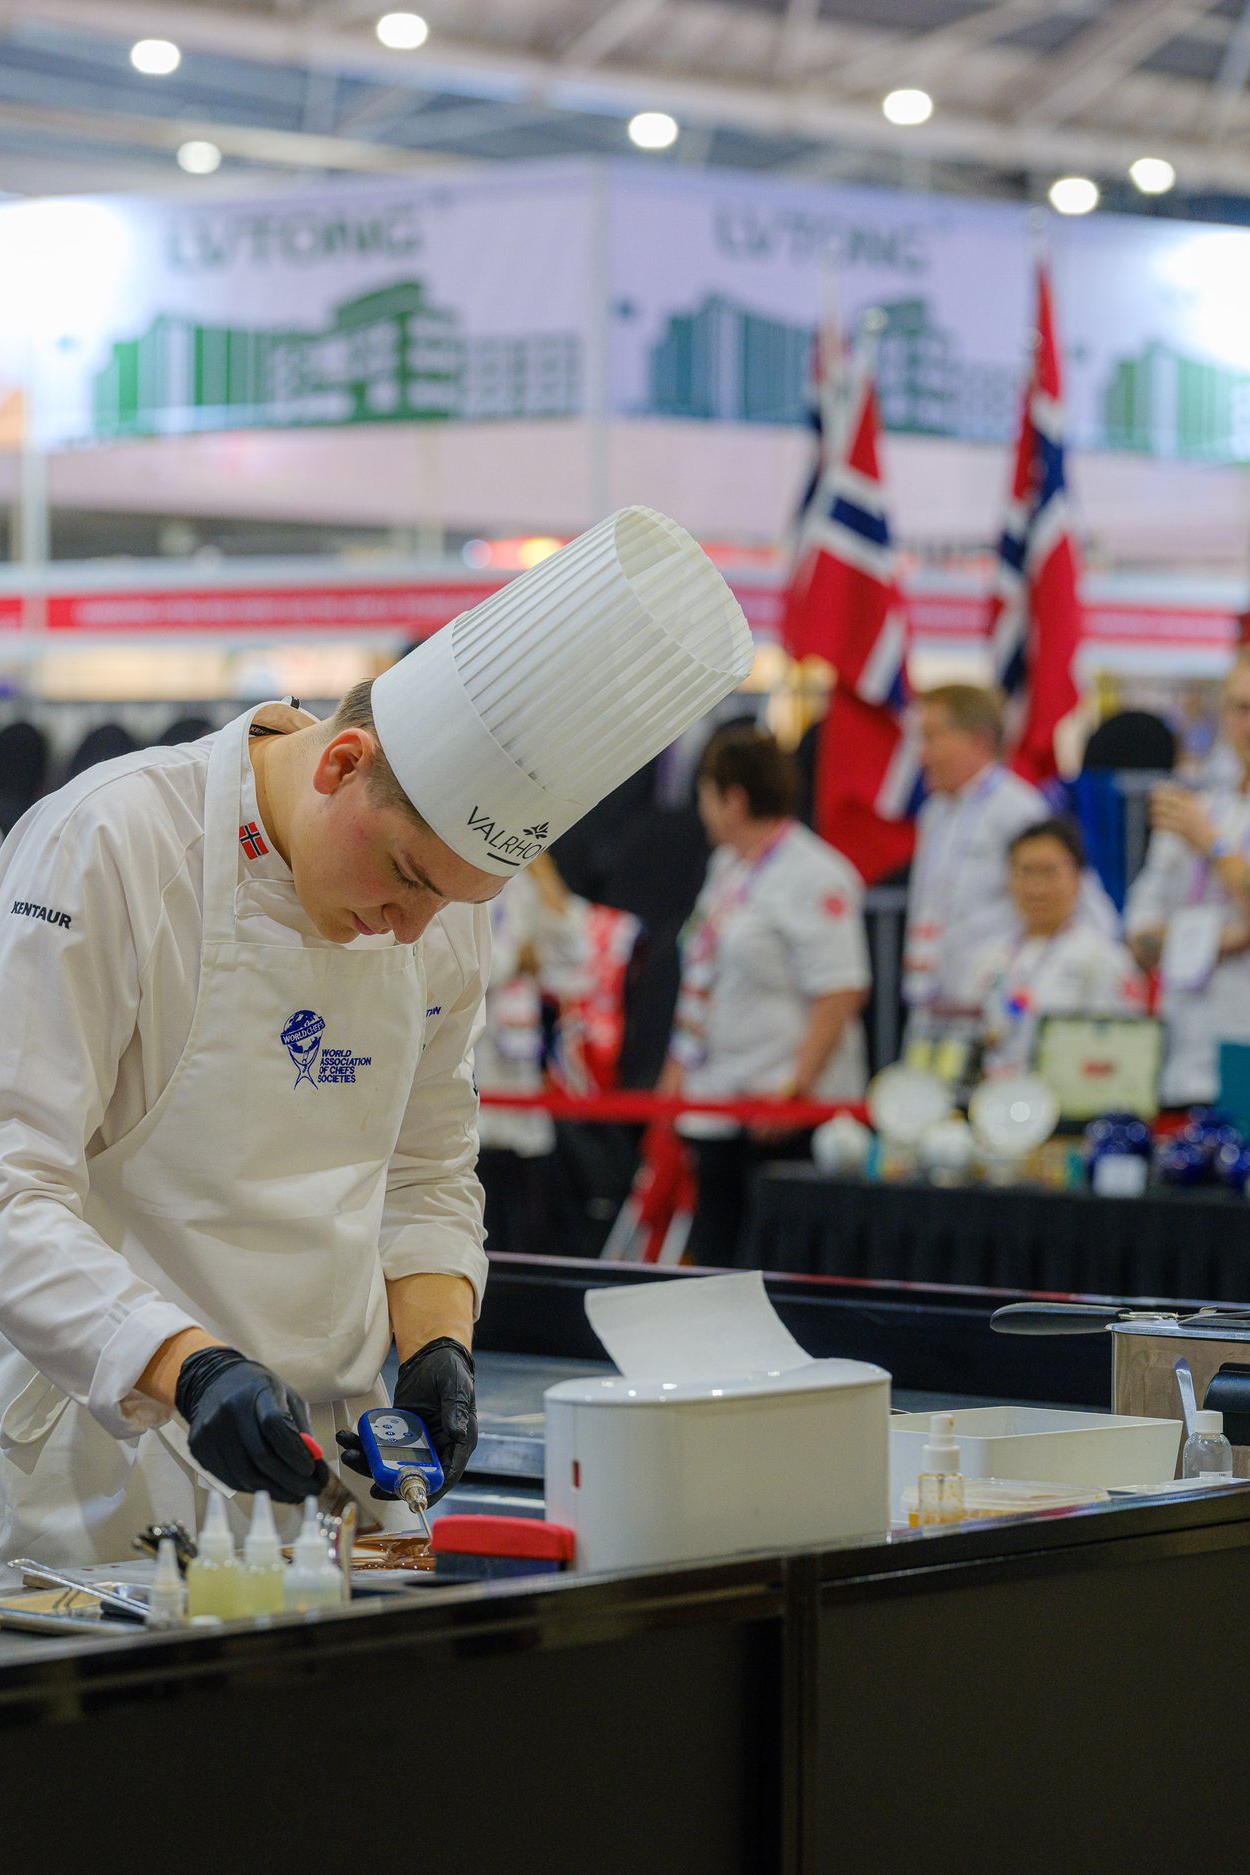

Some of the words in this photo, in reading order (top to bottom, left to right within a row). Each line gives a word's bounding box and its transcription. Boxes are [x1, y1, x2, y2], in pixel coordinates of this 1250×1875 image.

[467, 805, 547, 859] VALRHO
[10, 900, 72, 929] KENTAUR
[322, 1049, 351, 1058] WORLD
[320, 1057, 371, 1066] ASSOCIATION
[319, 1066, 329, 1075] OF
[318, 1075, 356, 1083] SOCIETIES
